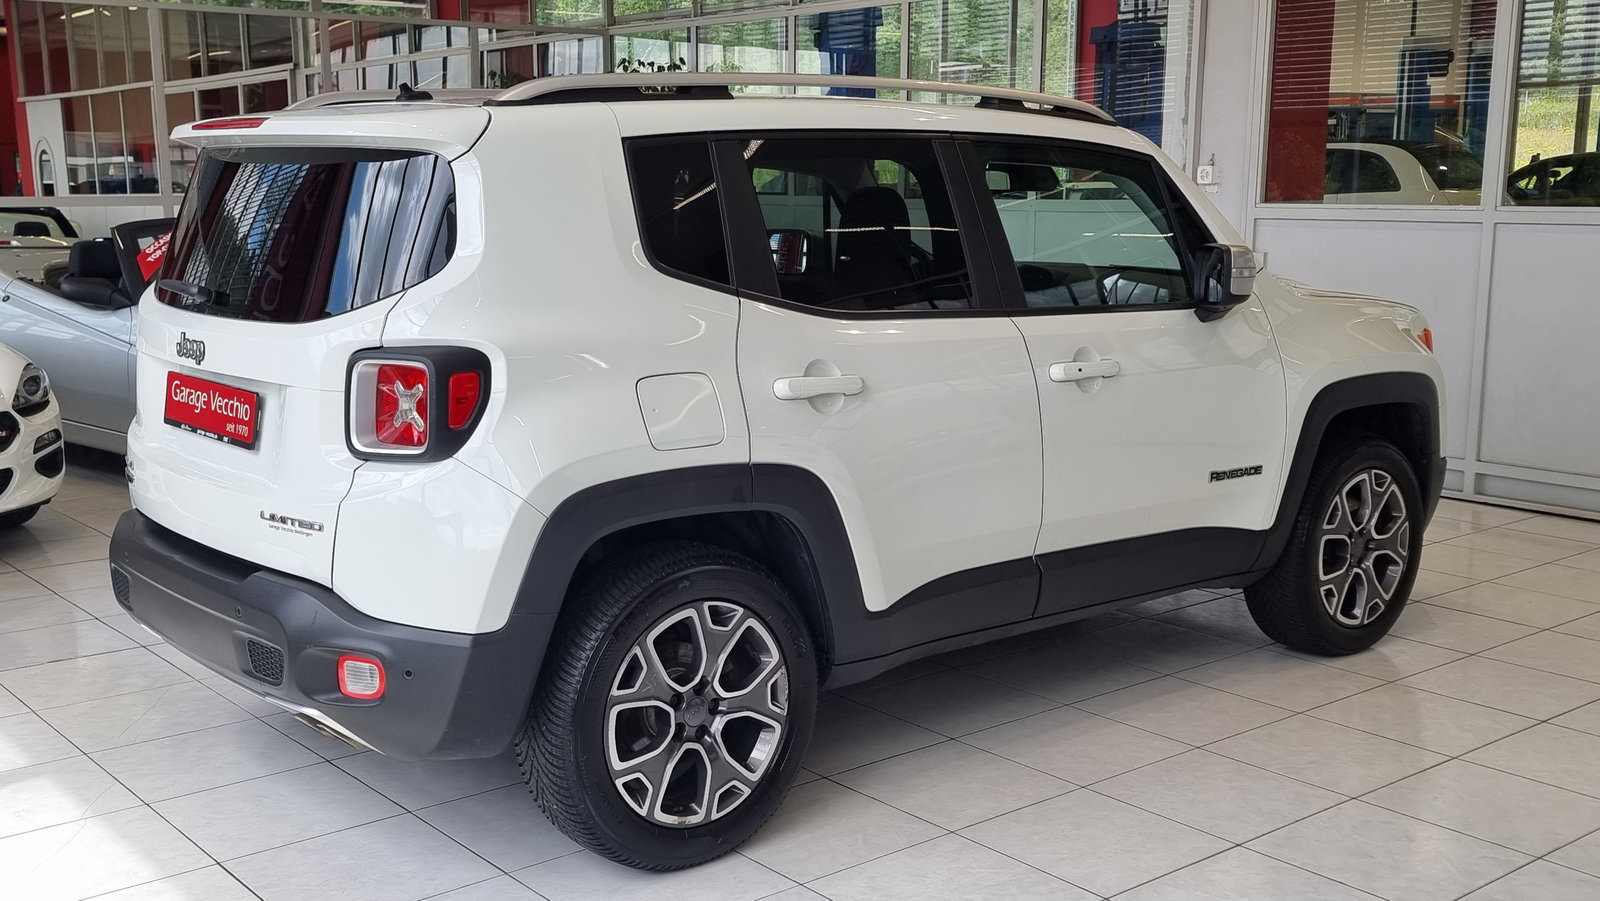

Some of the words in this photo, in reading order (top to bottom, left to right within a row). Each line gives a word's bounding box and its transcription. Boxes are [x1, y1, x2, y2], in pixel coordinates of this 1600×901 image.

[176, 332, 206, 365] Jeep
[171, 380, 208, 413] Garage
[209, 389, 251, 421] Vecchio
[225, 422, 235, 434] seit
[235, 424, 249, 437] 1970
[1208, 464, 1263, 484] RENEGADE
[260, 510, 324, 532] LIMITED
